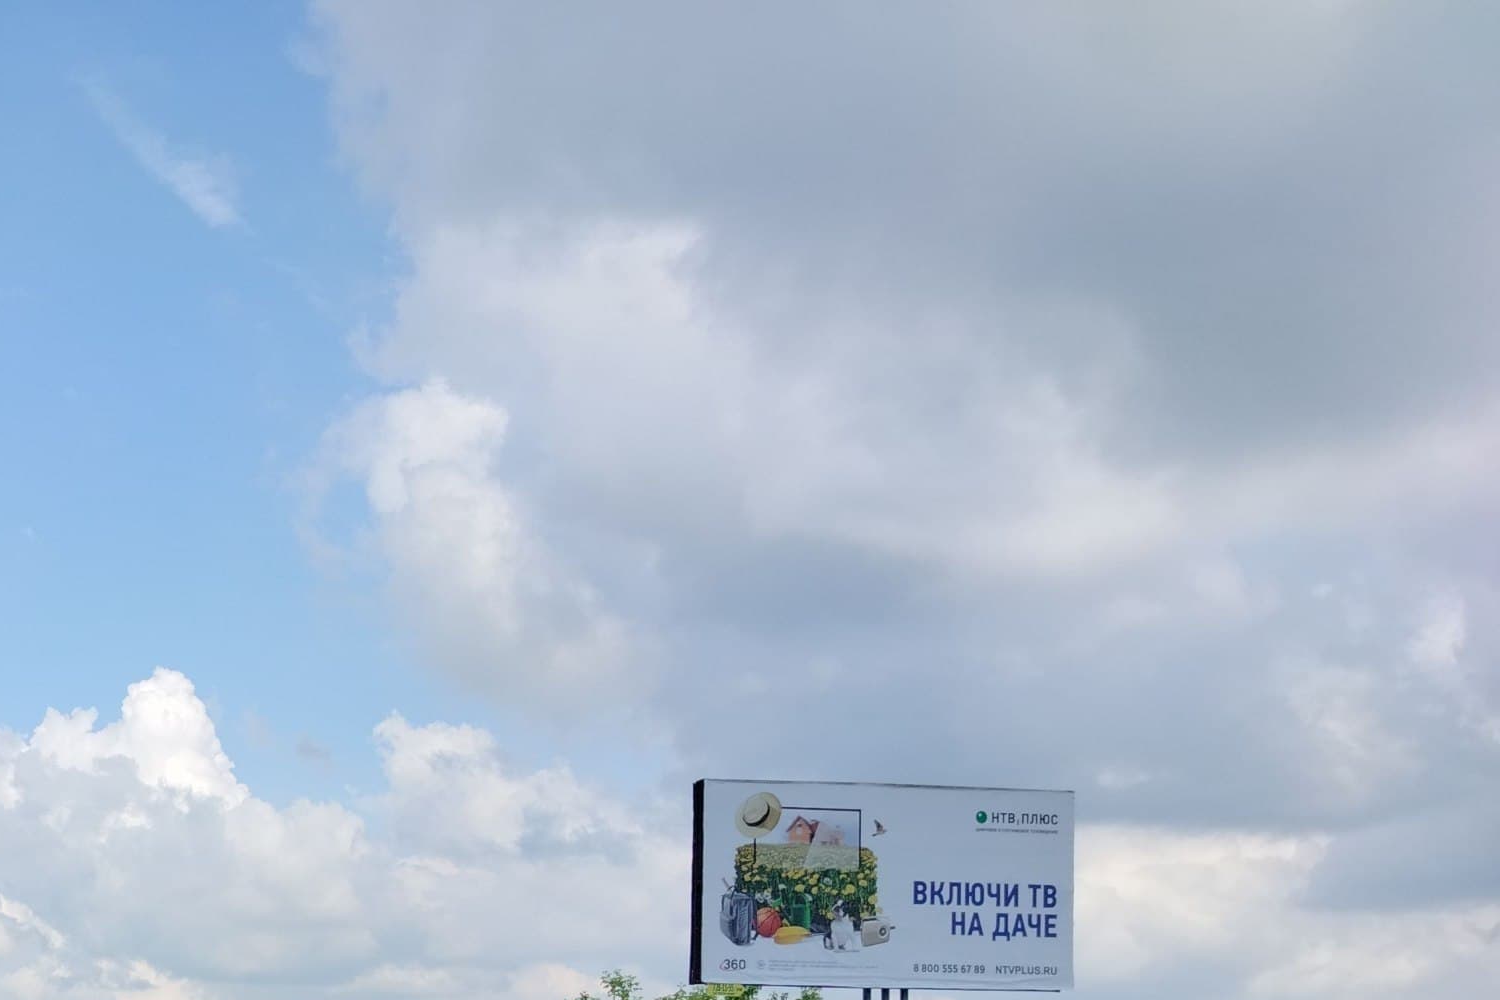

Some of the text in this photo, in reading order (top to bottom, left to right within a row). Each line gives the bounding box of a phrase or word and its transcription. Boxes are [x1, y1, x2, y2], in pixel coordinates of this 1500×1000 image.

[913, 880, 1057, 908] ВКЛЮЧИ ТВ
[951, 911, 1057, 941] НА ДАЧЕ
[723, 958, 746, 970] 360
[921, 963, 940, 973] 800
[942, 964, 958, 974] 555
[960, 964, 971, 974] 67
[974, 964, 986, 974] 89
[995, 965, 1058, 975] NTVPLUS.RU
